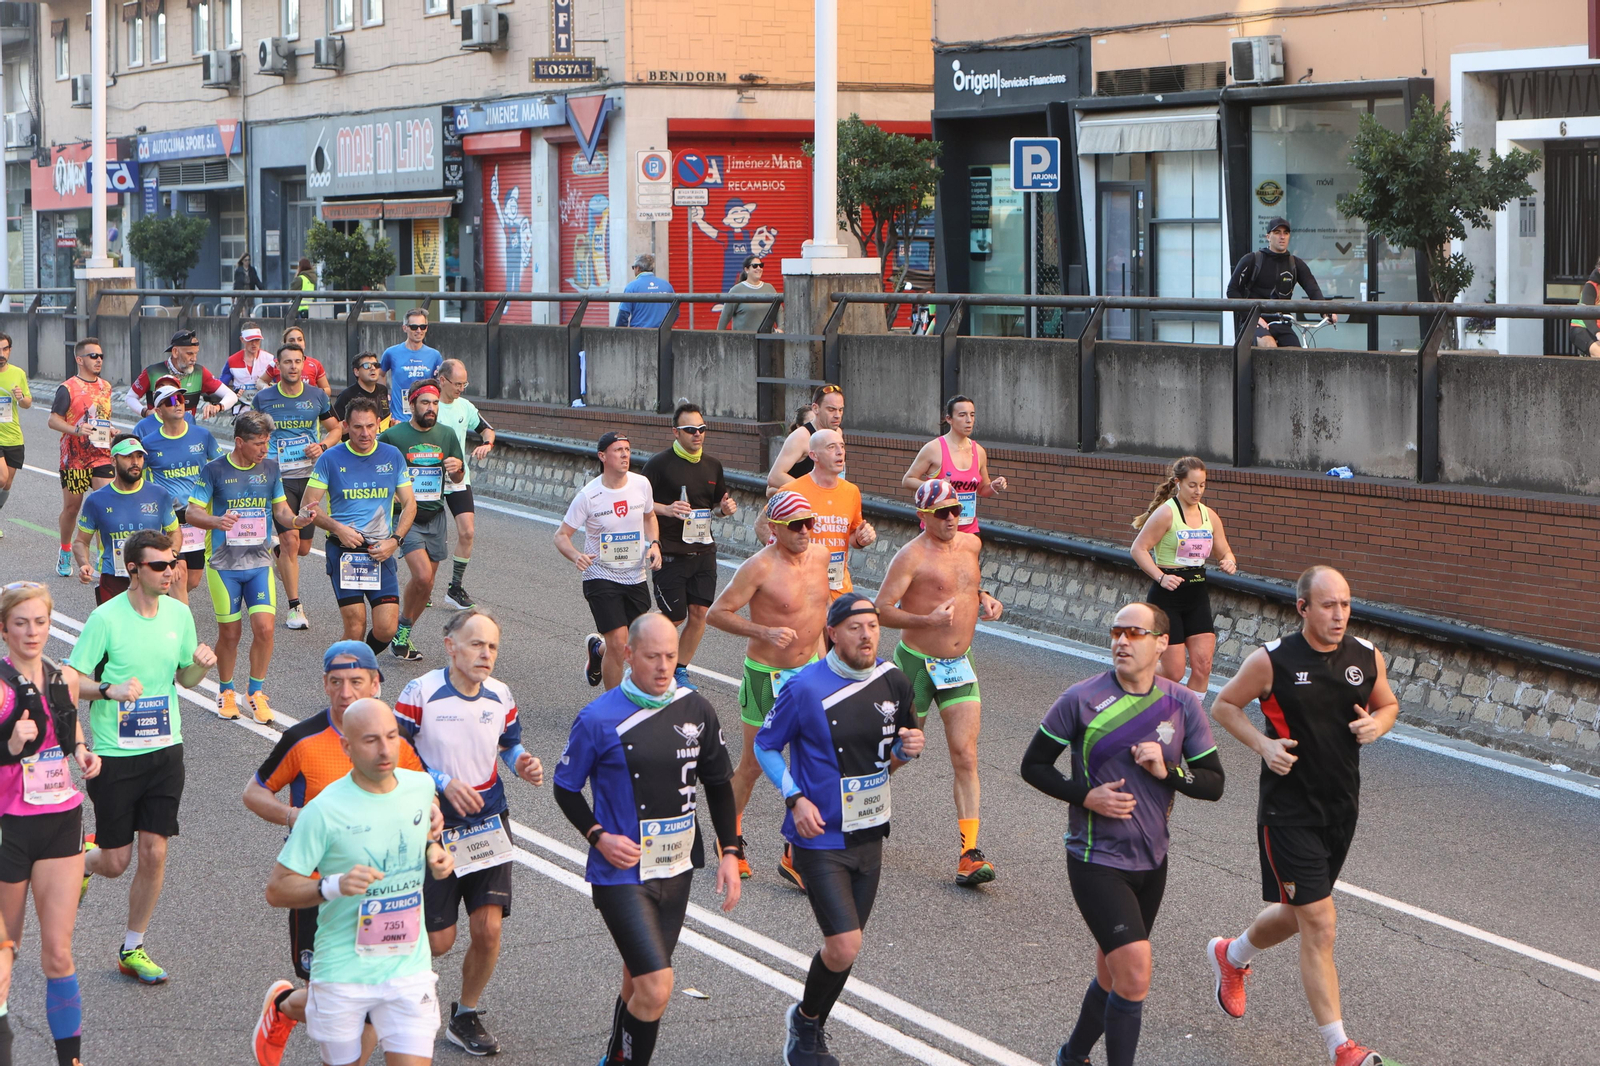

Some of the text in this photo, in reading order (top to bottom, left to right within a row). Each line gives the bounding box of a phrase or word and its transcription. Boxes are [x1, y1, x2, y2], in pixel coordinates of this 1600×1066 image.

[538, 64, 590, 75] HOSTAL
[649, 70, 727, 82] BENIDORM
[953, 68, 1066, 95] Origen Servicios Financieros
[485, 105, 518, 126] JIMENEZ
[1560, 120, 1567, 137] 6
[152, 138, 185, 155] AUTOCLIMA
[726, 154, 802, 173] Jiménez Maña
[1022, 146, 1051, 186] P
[728, 180, 785, 191] RECAMBIOS
[1316, 178, 1334, 186] móvil
[275, 420, 312, 429] TUSSAM
[163, 466, 199, 479] TUSSAM
[342, 488, 388, 500] TUSSAM
[227, 498, 267, 508] TUSSAM
[811, 512, 849, 525] Frutas
[813, 523, 848, 534] Sousa
[139, 700, 164, 708] ZURICH
[136, 717, 157, 726] 12293
[43, 751, 64, 759] ZURI
[676, 746, 701, 759] JOAQU
[45, 770, 63, 778] 7564
[864, 774, 888, 788] ZURIC
[864, 794, 881, 805] 8920
[858, 807, 874, 818] RAÚL
[462, 820, 494, 836] ZURICH
[664, 819, 691, 832] ZURICH
[466, 840, 490, 853] 10268
[470, 850, 494, 861] MAURO
[385, 896, 418, 910] ZURICH
[384, 920, 404, 930] 7351
[381, 934, 406, 942] JONNY
